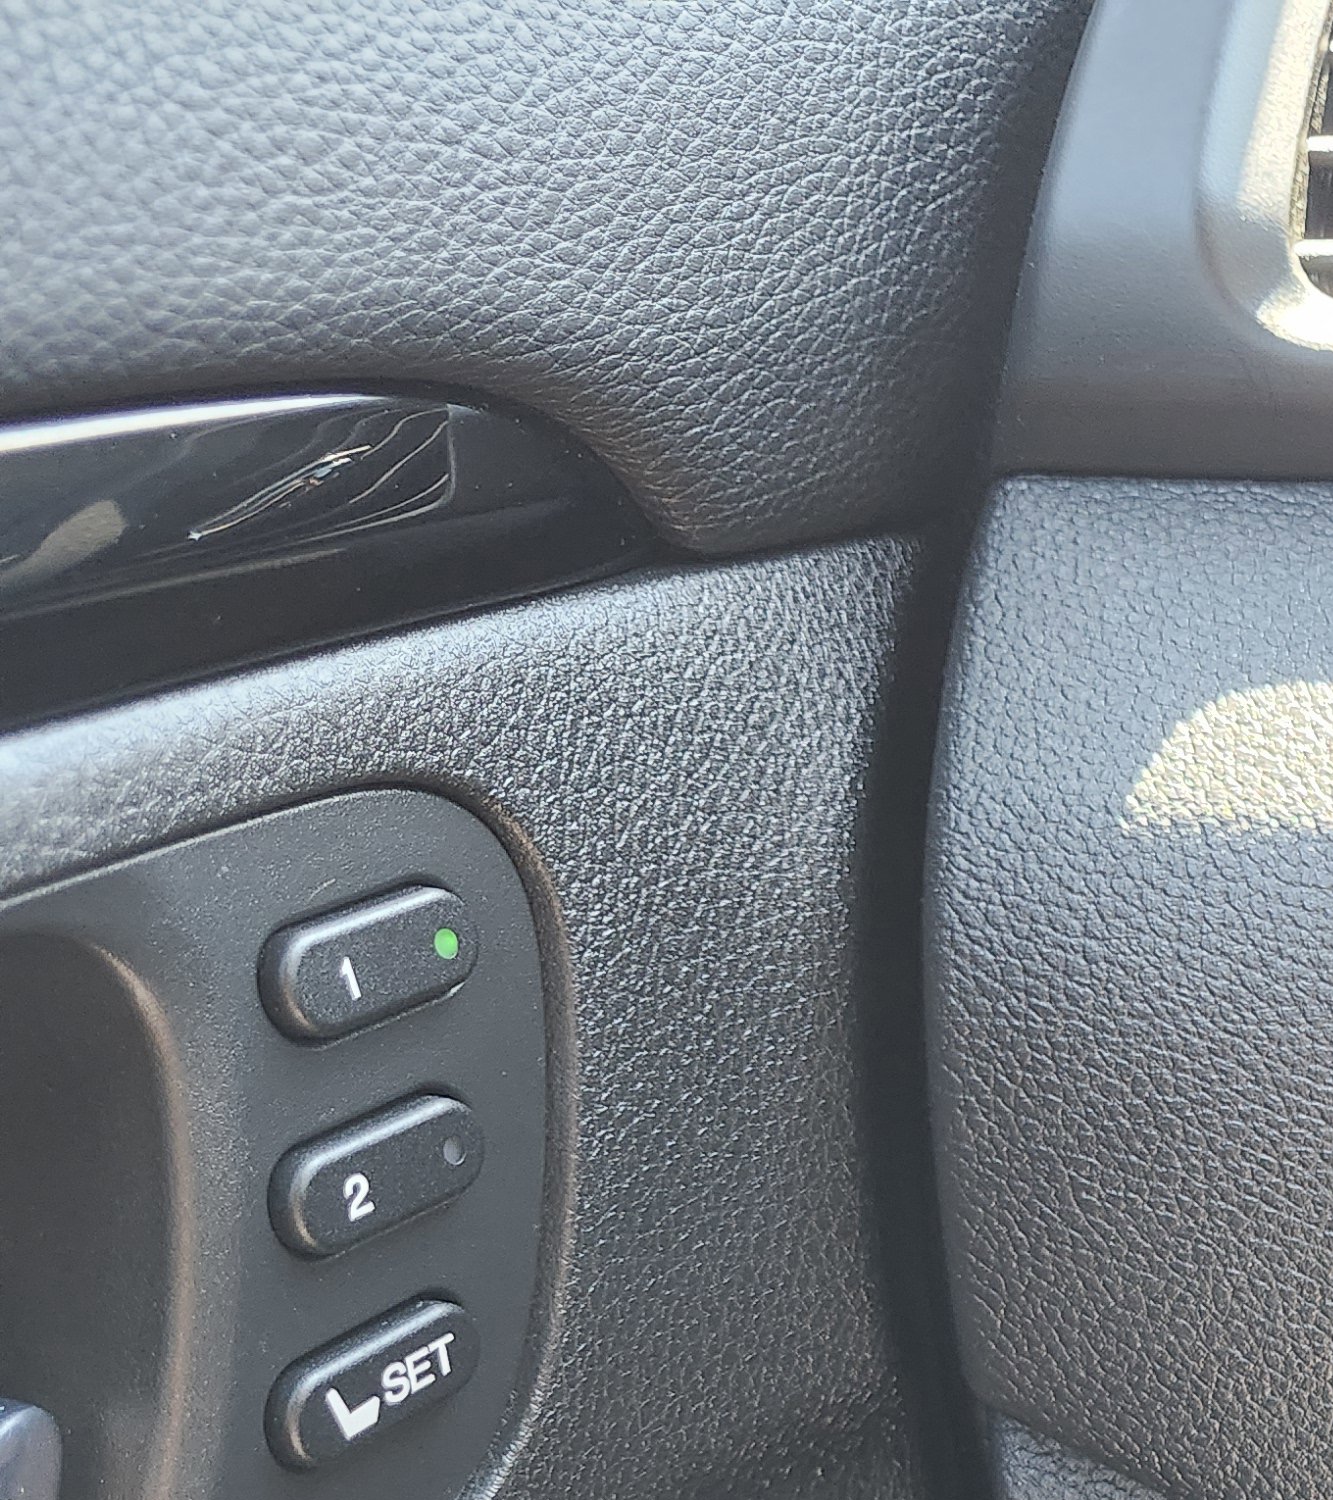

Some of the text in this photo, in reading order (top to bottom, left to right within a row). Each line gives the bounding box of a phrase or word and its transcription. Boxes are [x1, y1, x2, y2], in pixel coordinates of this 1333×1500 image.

[335, 957, 362, 1000] 1
[341, 1172, 376, 1221] 2
[380, 1332, 456, 1404] SET
